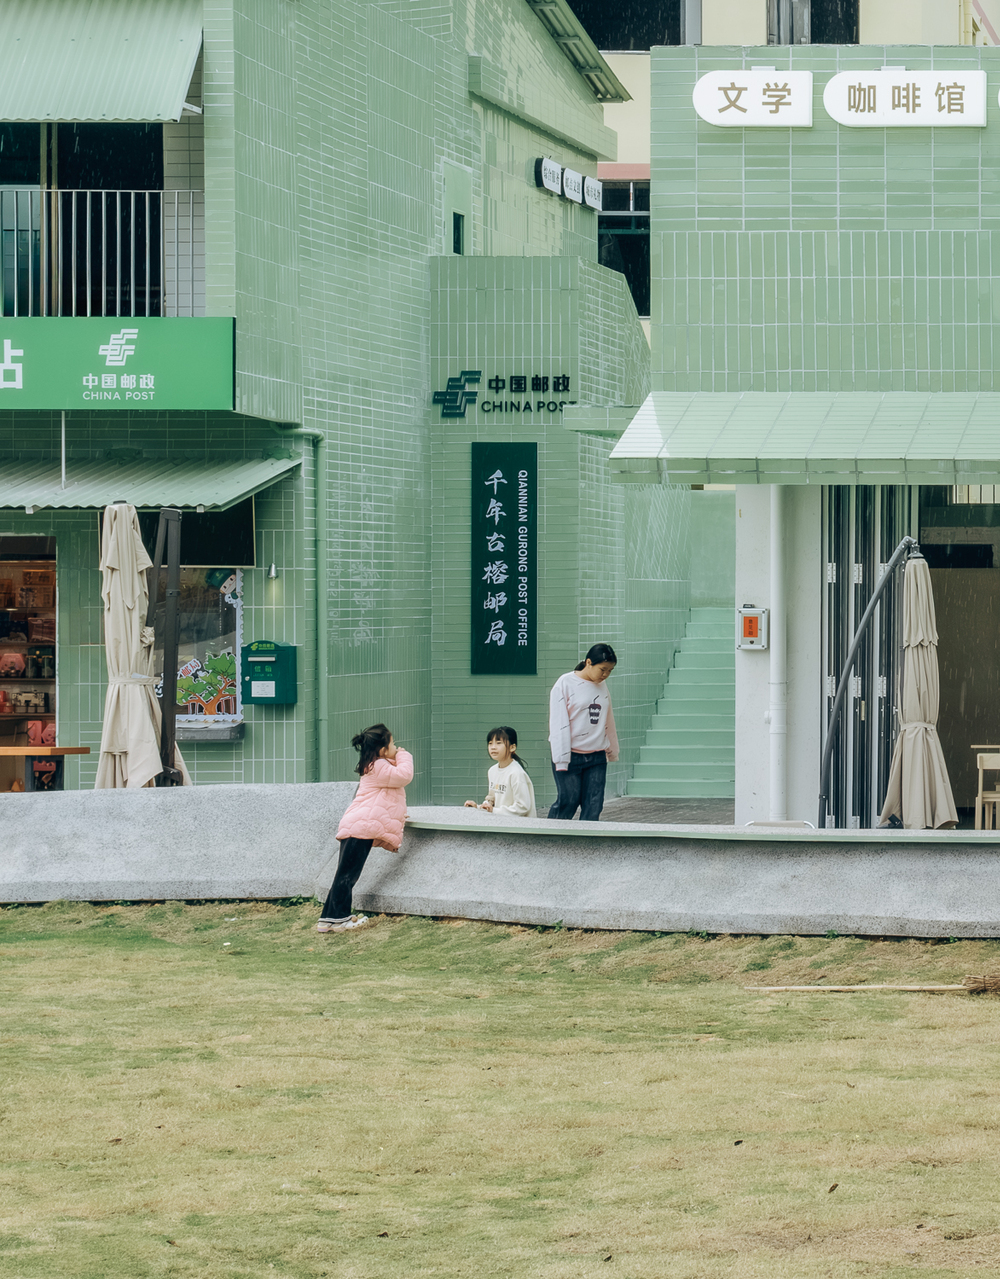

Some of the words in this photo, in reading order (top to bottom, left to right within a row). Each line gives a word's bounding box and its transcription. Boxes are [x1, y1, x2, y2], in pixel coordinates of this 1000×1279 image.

[717, 81, 792, 114] 文学
[847, 81, 966, 114] 咖啡馆
[82, 373, 155, 389] 中国邮政
[82, 391, 121, 401] CHINA
[125, 391, 156, 401] POST
[488, 374, 570, 394] 中国邮政
[481, 400, 533, 413] CHINA
[536, 400, 577, 413] POS
[517, 469, 528, 522] QIANNIAN
[481, 469, 509, 646] 千年古榕邮局
[517, 525, 528, 573] GURONG
[517, 576, 528, 605] POST
[517, 608, 528, 646] OFFICE
